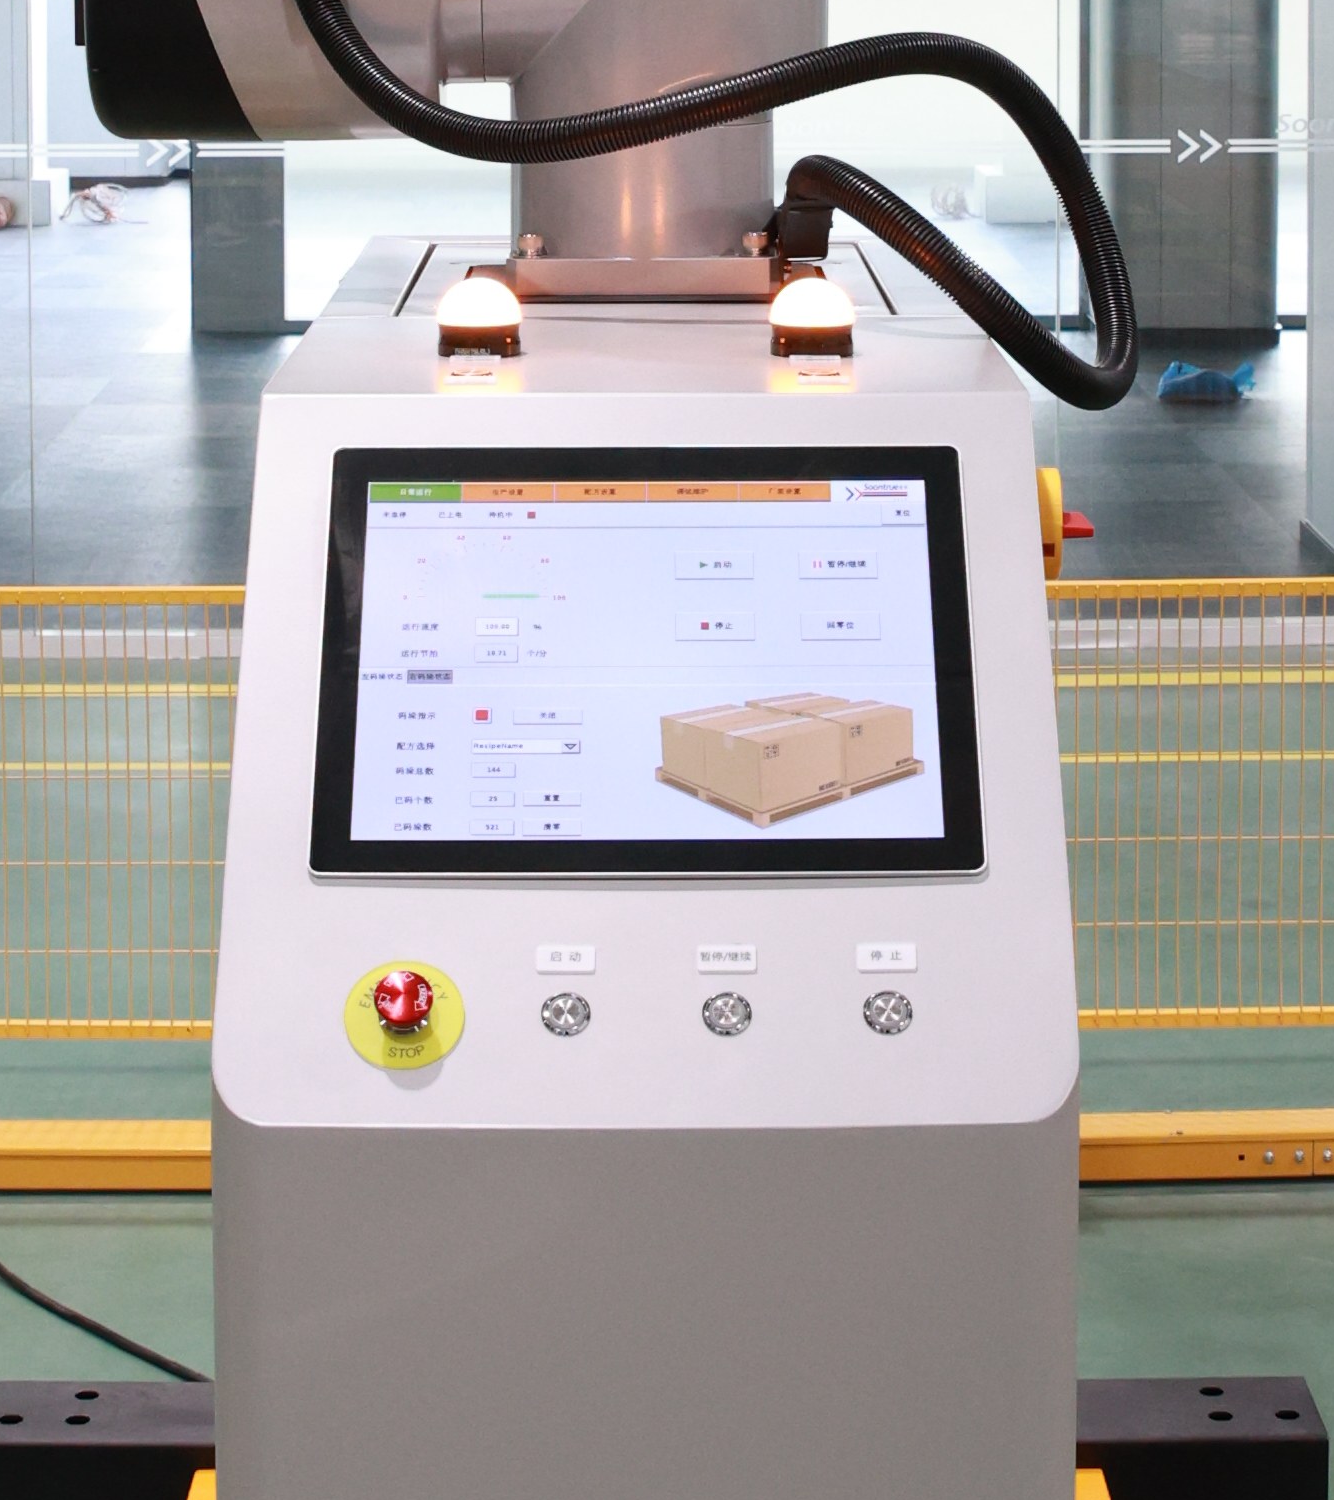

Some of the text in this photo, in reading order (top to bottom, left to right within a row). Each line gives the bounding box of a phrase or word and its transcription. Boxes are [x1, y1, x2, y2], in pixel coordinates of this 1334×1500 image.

[827, 560, 867, 568] 暂停/继续
[402, 623, 439, 631] 运行速度
[715, 621, 733, 630] 停止
[401, 649, 438, 658] 运行节拍
[396, 742, 435, 750] 配方选择
[700, 951, 752, 962] 暂停/继续
[387, 1045, 425, 1059] STOP
